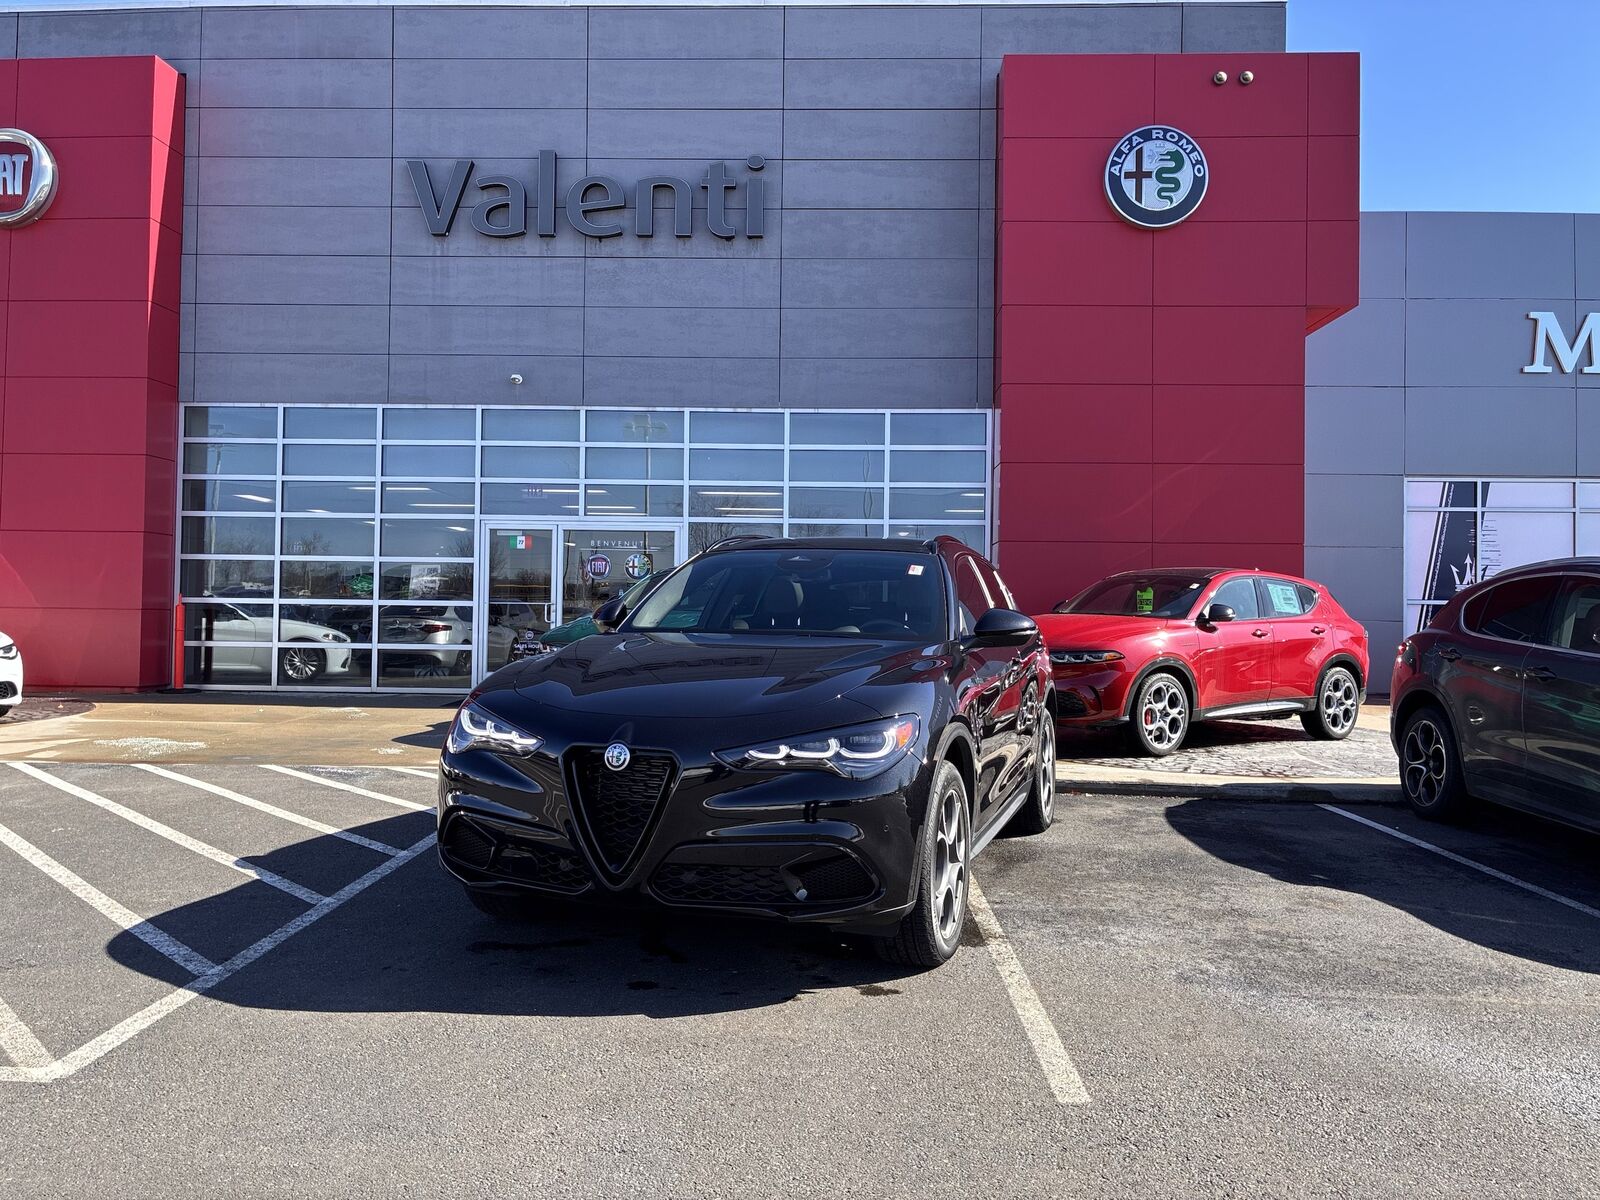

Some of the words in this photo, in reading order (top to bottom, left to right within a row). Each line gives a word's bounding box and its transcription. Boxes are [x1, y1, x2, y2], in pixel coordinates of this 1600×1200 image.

[1110, 135, 1144, 176] ALFA
[1152, 129, 1204, 177] ROMEO
[405, 150, 766, 239] Valenti
[1523, 311, 1600, 374] M
[591, 561, 607, 573] FIAT
